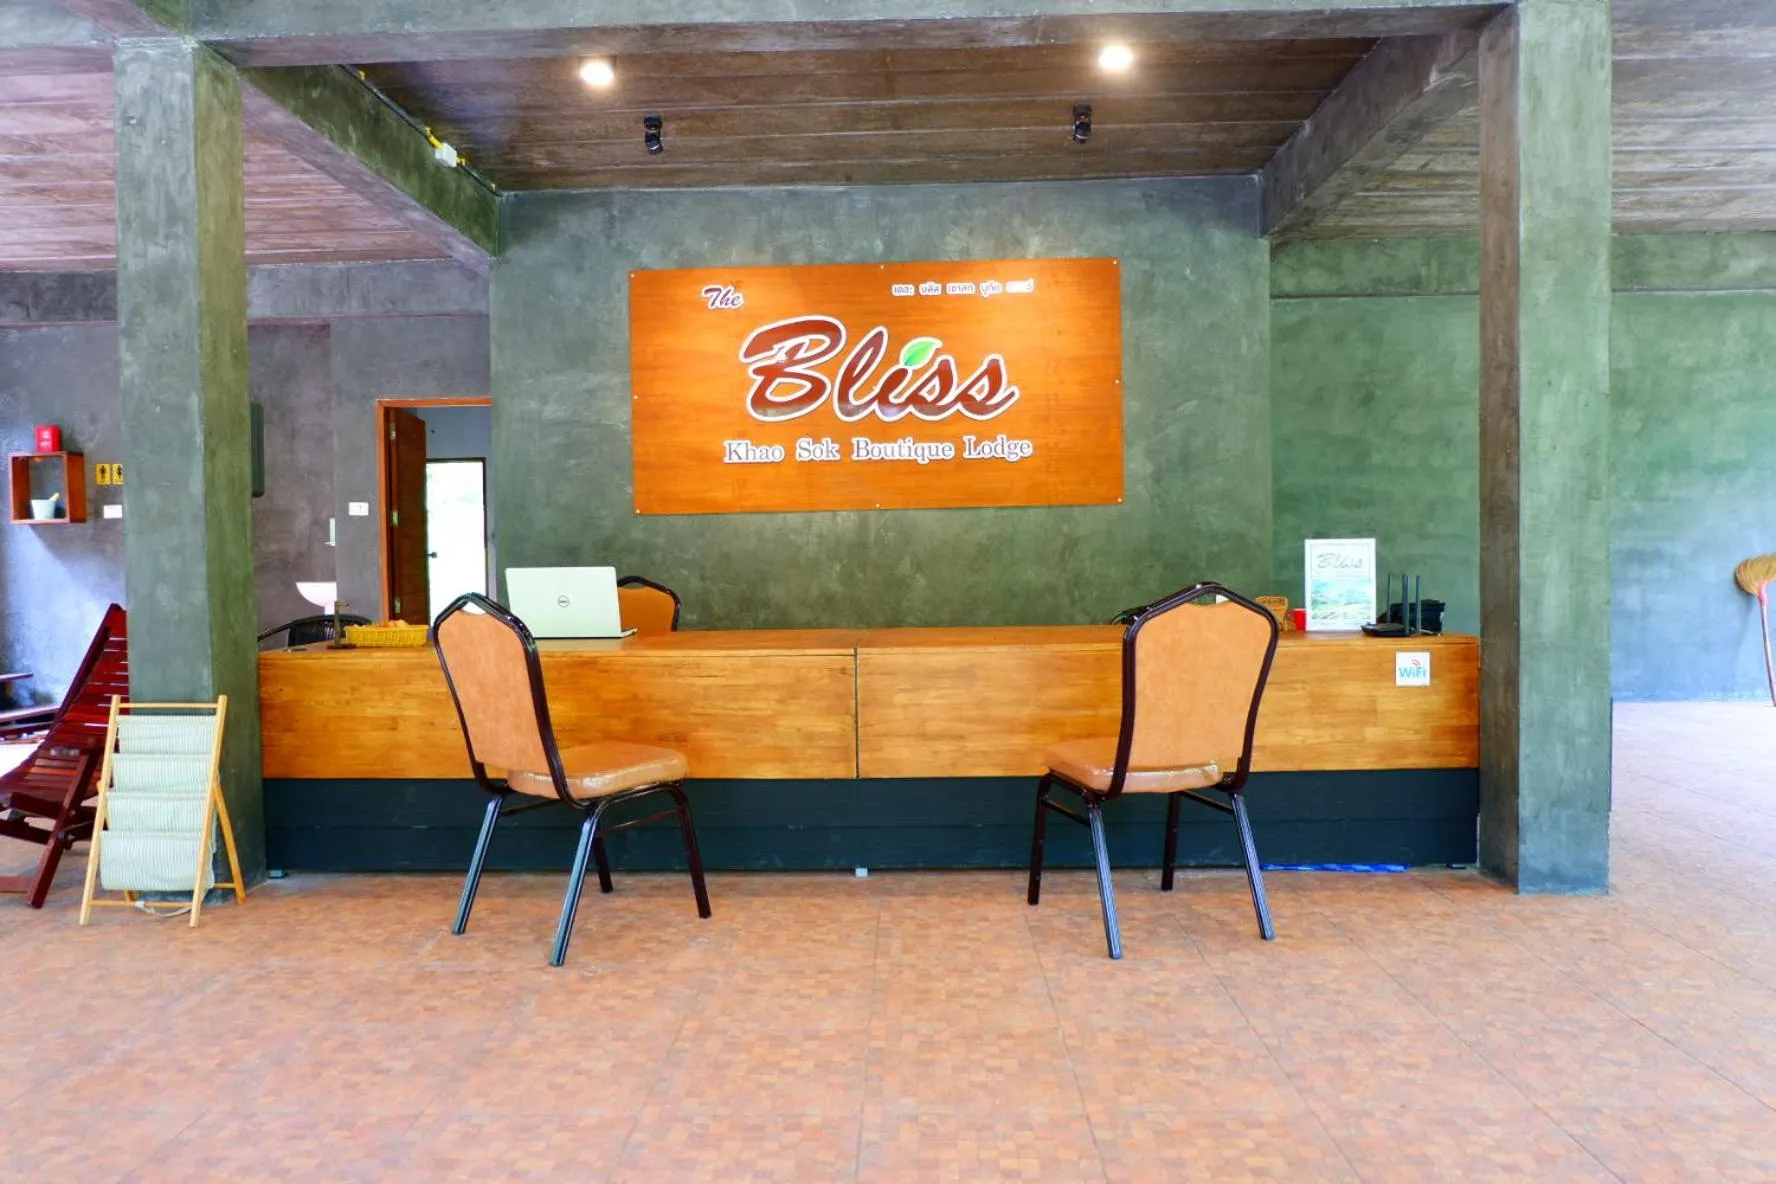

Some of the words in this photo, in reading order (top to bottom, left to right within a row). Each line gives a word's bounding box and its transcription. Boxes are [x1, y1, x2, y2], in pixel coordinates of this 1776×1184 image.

[702, 286, 743, 308] The
[740, 315, 1019, 421] Bliss
[724, 441, 784, 462] Khao
[797, 438, 840, 460] Sok
[852, 438, 954, 463] Boutique
[963, 436, 1031, 460] Lodge
[1398, 666, 1427, 679] WiFi
